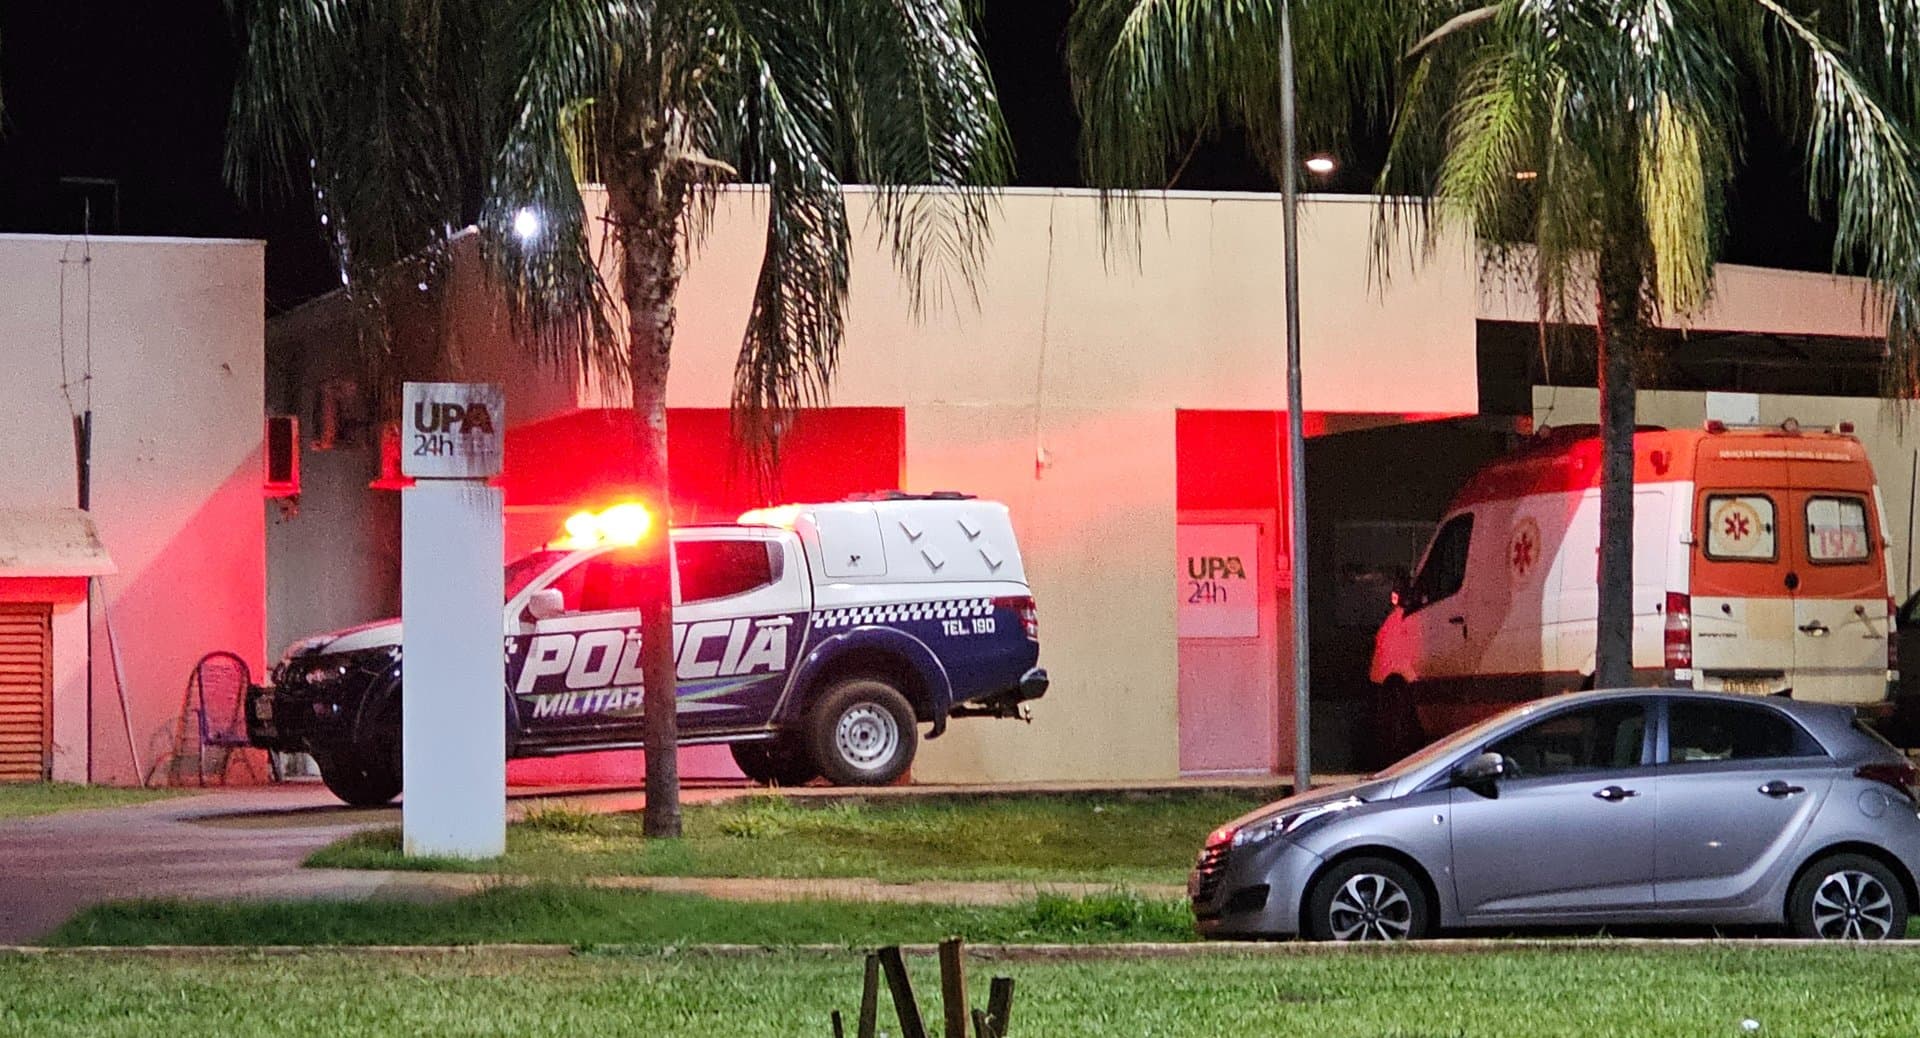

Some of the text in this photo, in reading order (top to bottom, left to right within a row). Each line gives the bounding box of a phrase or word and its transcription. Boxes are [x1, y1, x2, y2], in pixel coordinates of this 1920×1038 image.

[414, 402, 494, 434] UPA
[413, 434, 454, 457] 24h
[1187, 556, 1246, 580] UPA
[1187, 581, 1227, 603] 24h
[972, 617, 996, 634] 190
[532, 687, 646, 718] MILITAR
